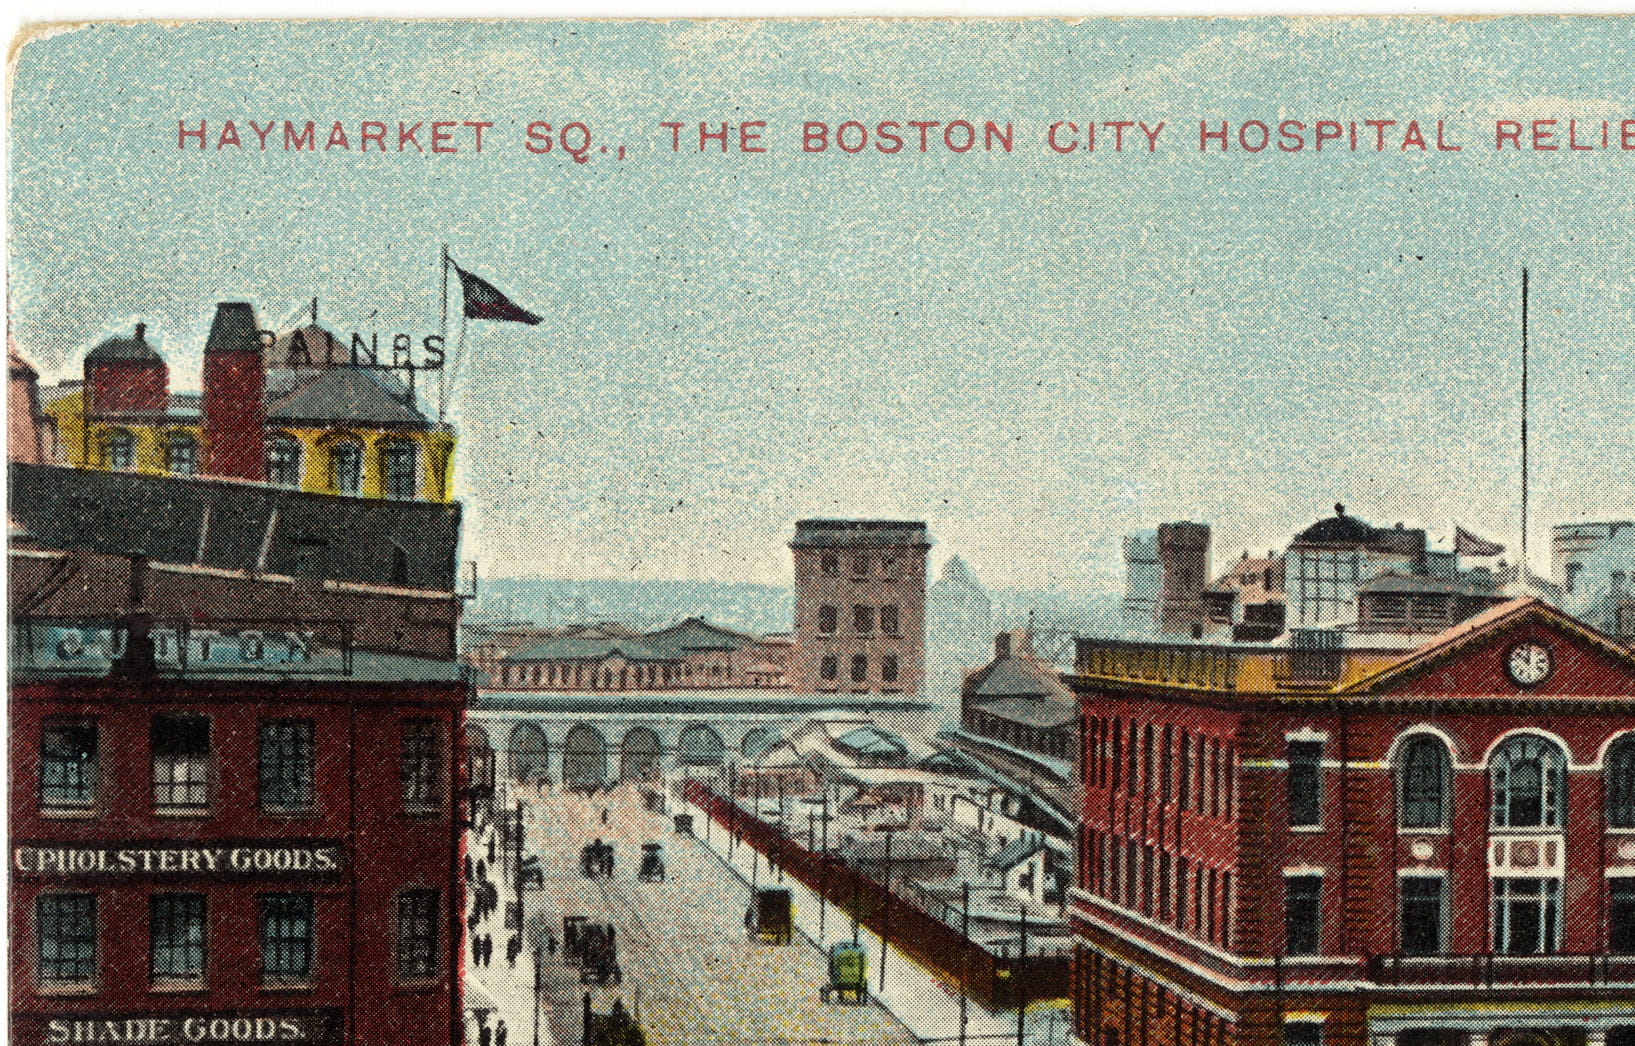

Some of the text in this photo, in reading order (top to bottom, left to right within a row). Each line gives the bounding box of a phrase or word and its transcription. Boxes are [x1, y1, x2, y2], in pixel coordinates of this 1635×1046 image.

[15, 847, 337, 874] UPHOLSTERY GOODS.
[45, 1015, 306, 1046] SHADE GOODS.
